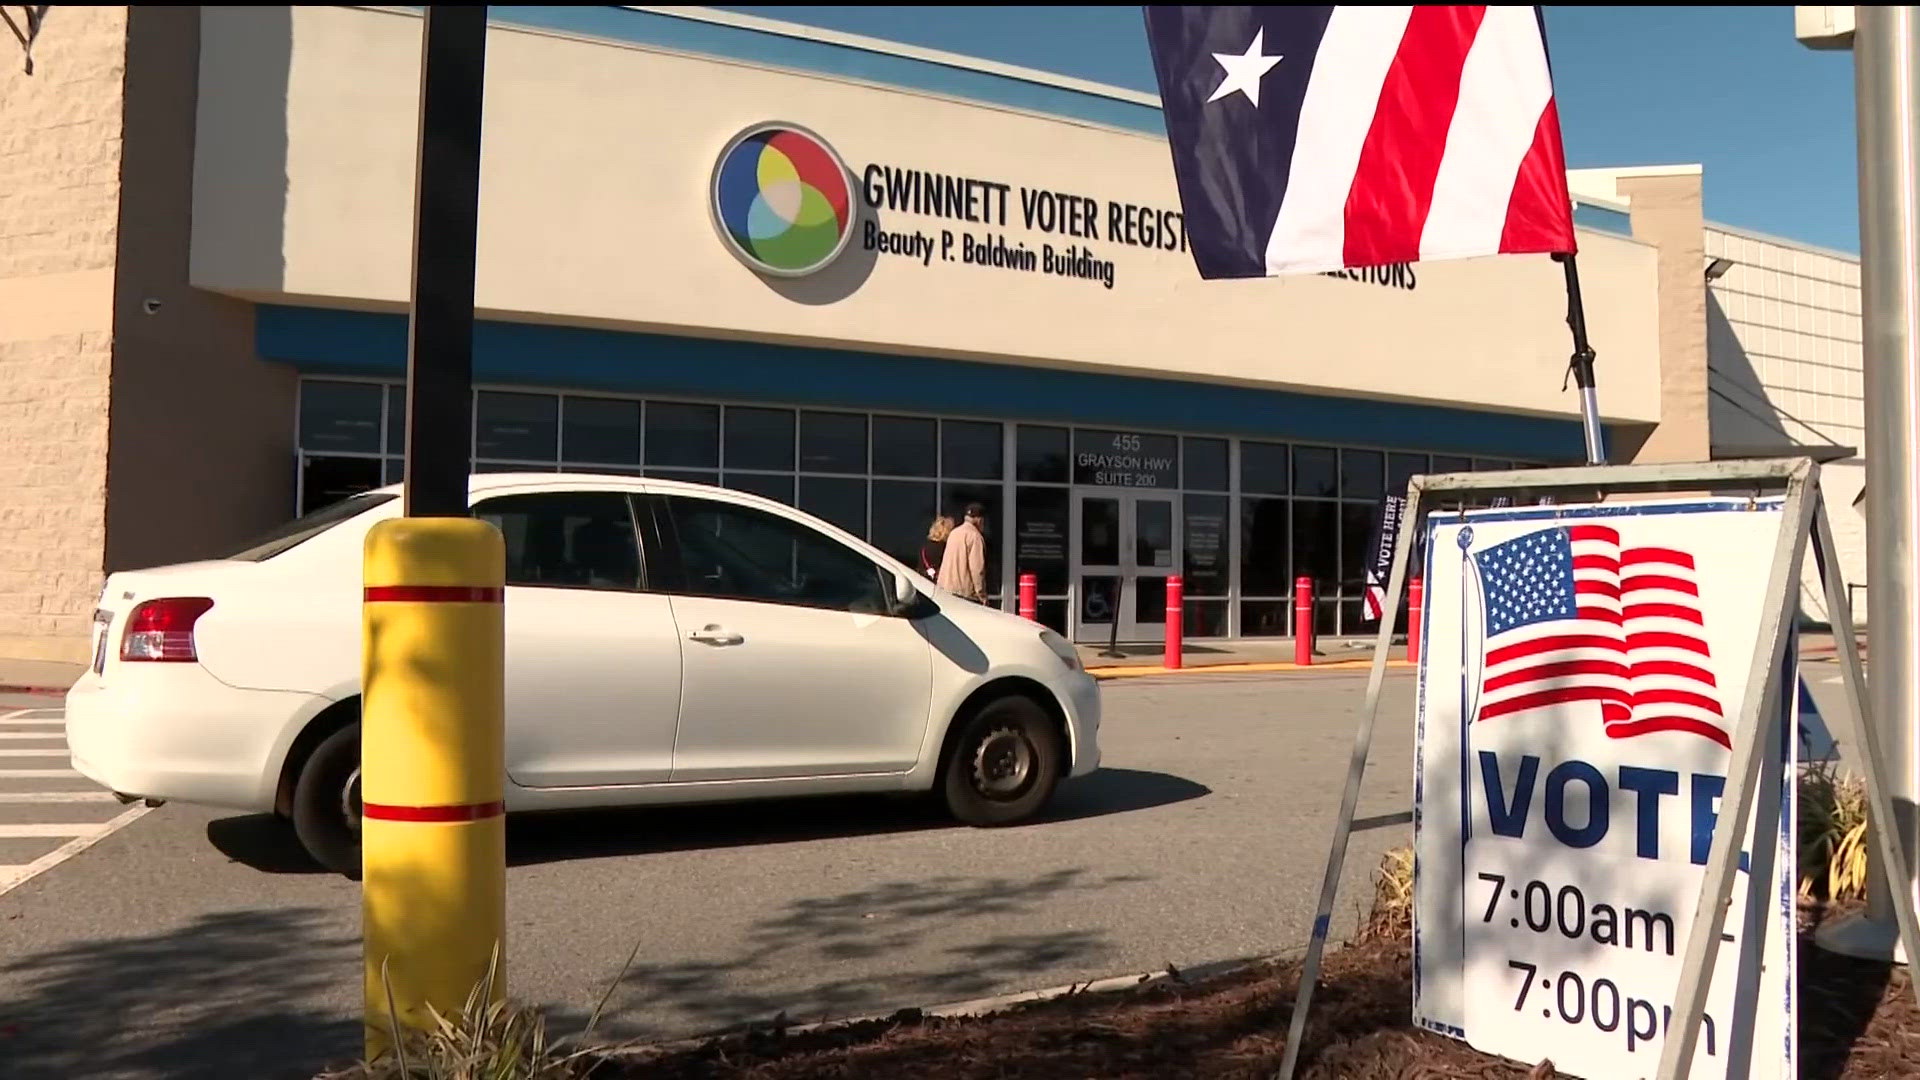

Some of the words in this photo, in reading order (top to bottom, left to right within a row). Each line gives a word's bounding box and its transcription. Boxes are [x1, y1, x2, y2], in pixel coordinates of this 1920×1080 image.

[863, 163, 1011, 226] GWINNETT
[1020, 187, 1100, 240] VOTER
[1107, 201, 1188, 253] REGIST
[863, 220, 935, 266] Beauty
[941, 230, 956, 263] P.
[962, 233, 1037, 272] Baldwin
[1042, 244, 1115, 290] Building
[1112, 433, 1141, 452] 455
[1078, 453, 1141, 470] GRAYSON
[1143, 457, 1173, 471] HWY
[1095, 471, 1132, 487] SUITE
[1134, 474, 1157, 488] 200
[1383, 495, 1398, 531] HERE
[1377, 533, 1394, 567] VOTE
[1478, 750, 1750, 873] VOTE
[1478, 872, 1675, 956] 7:00am
